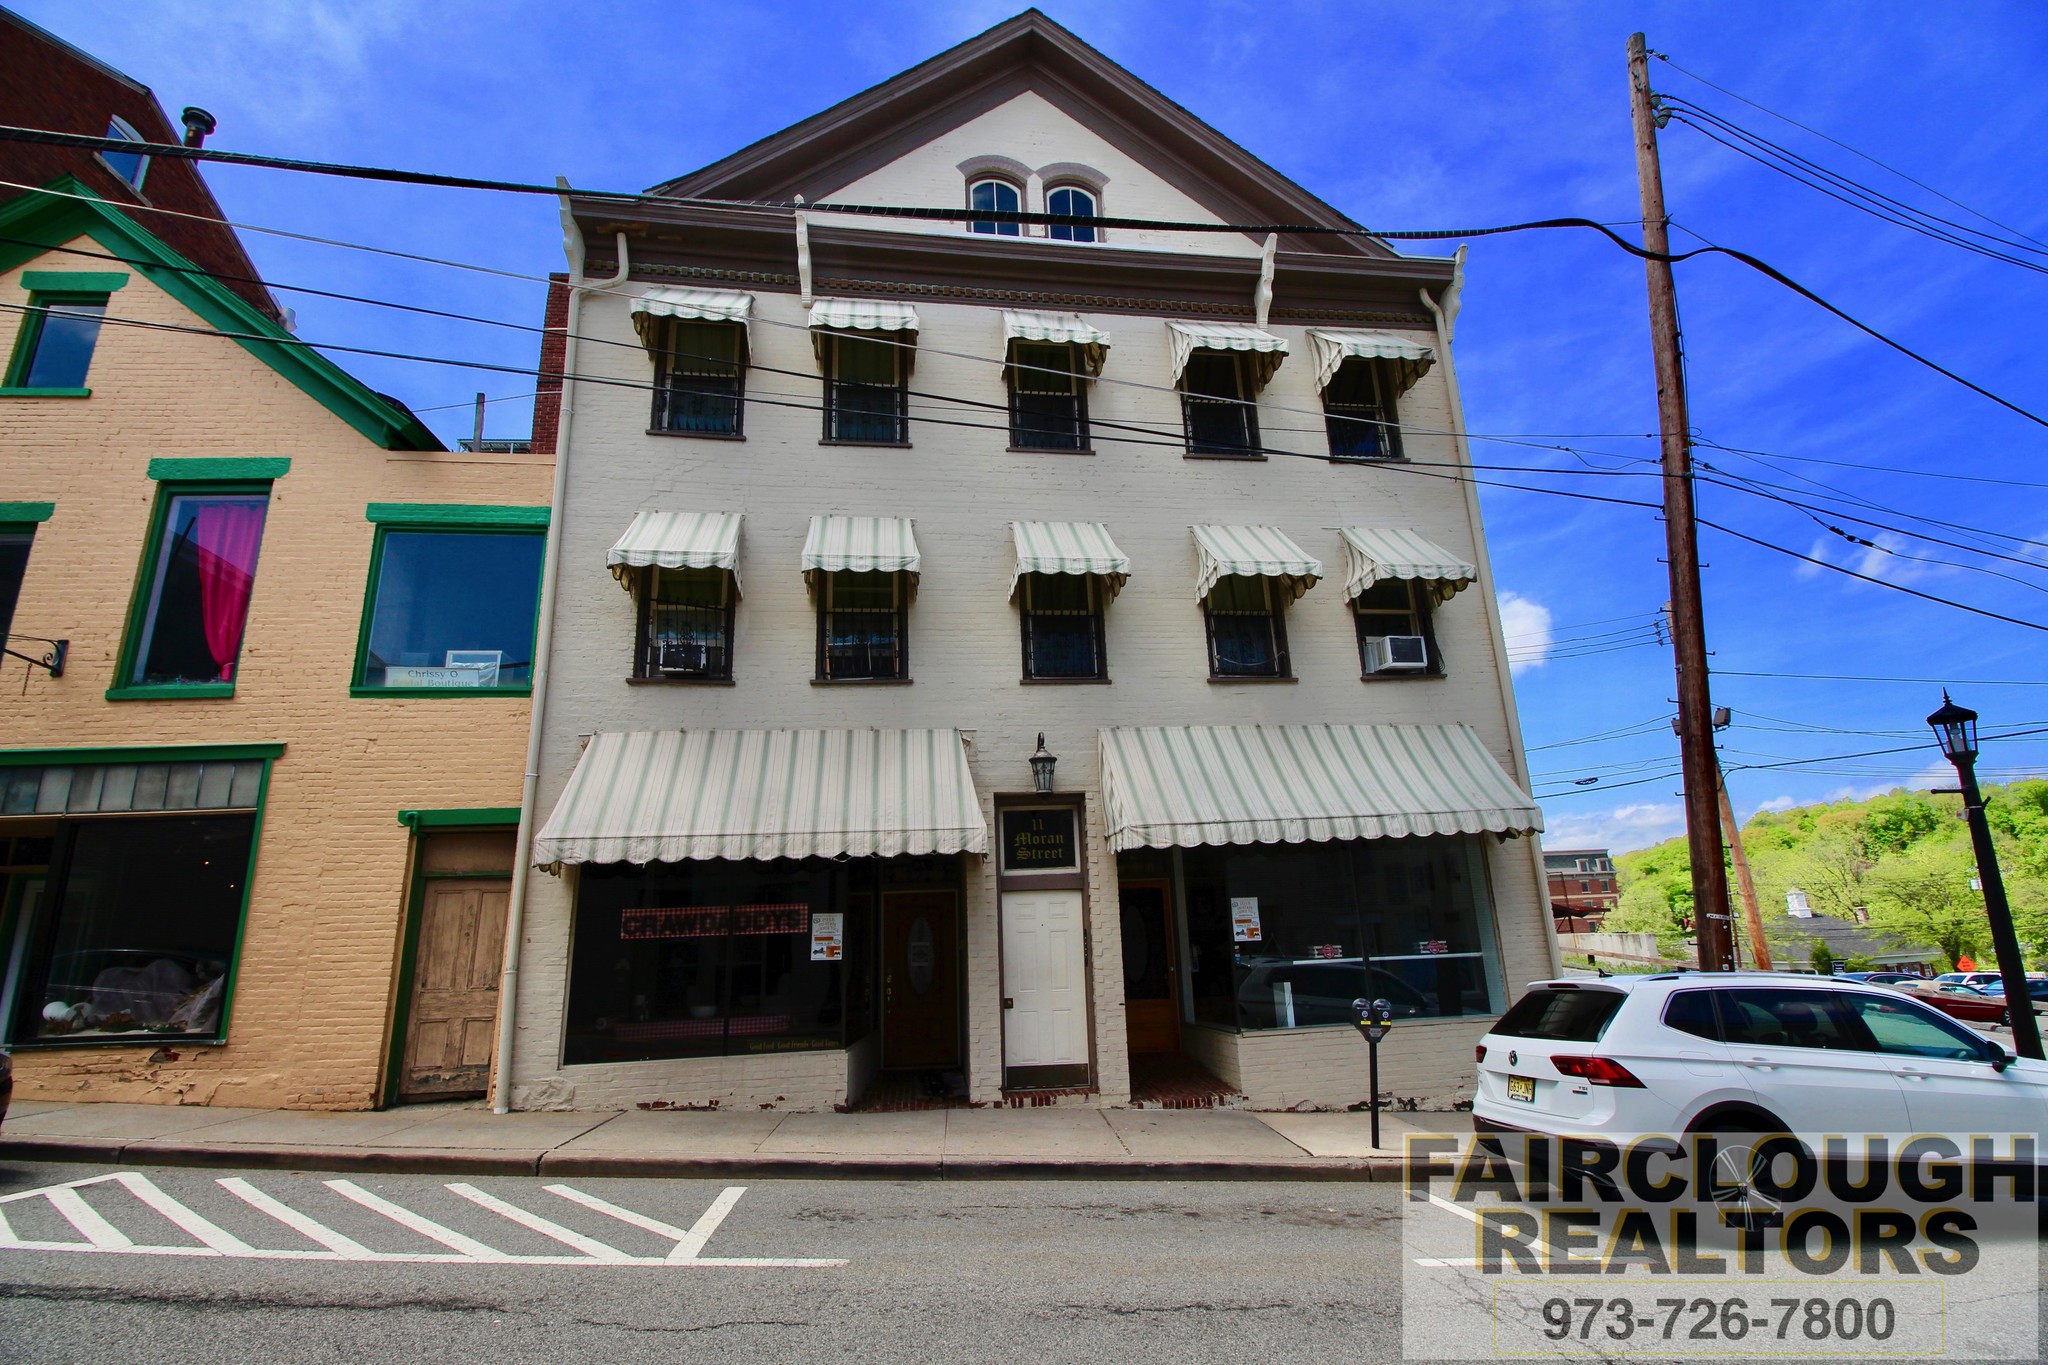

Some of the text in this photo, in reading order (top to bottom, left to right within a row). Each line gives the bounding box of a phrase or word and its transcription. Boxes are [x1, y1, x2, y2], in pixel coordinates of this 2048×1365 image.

[408, 669, 459, 679] Chrissy O
[428, 679, 474, 687] Boutique
[1032, 818, 1044, 831] 11
[1014, 832, 1064, 846] Moran
[1016, 847, 1063, 860] Street
